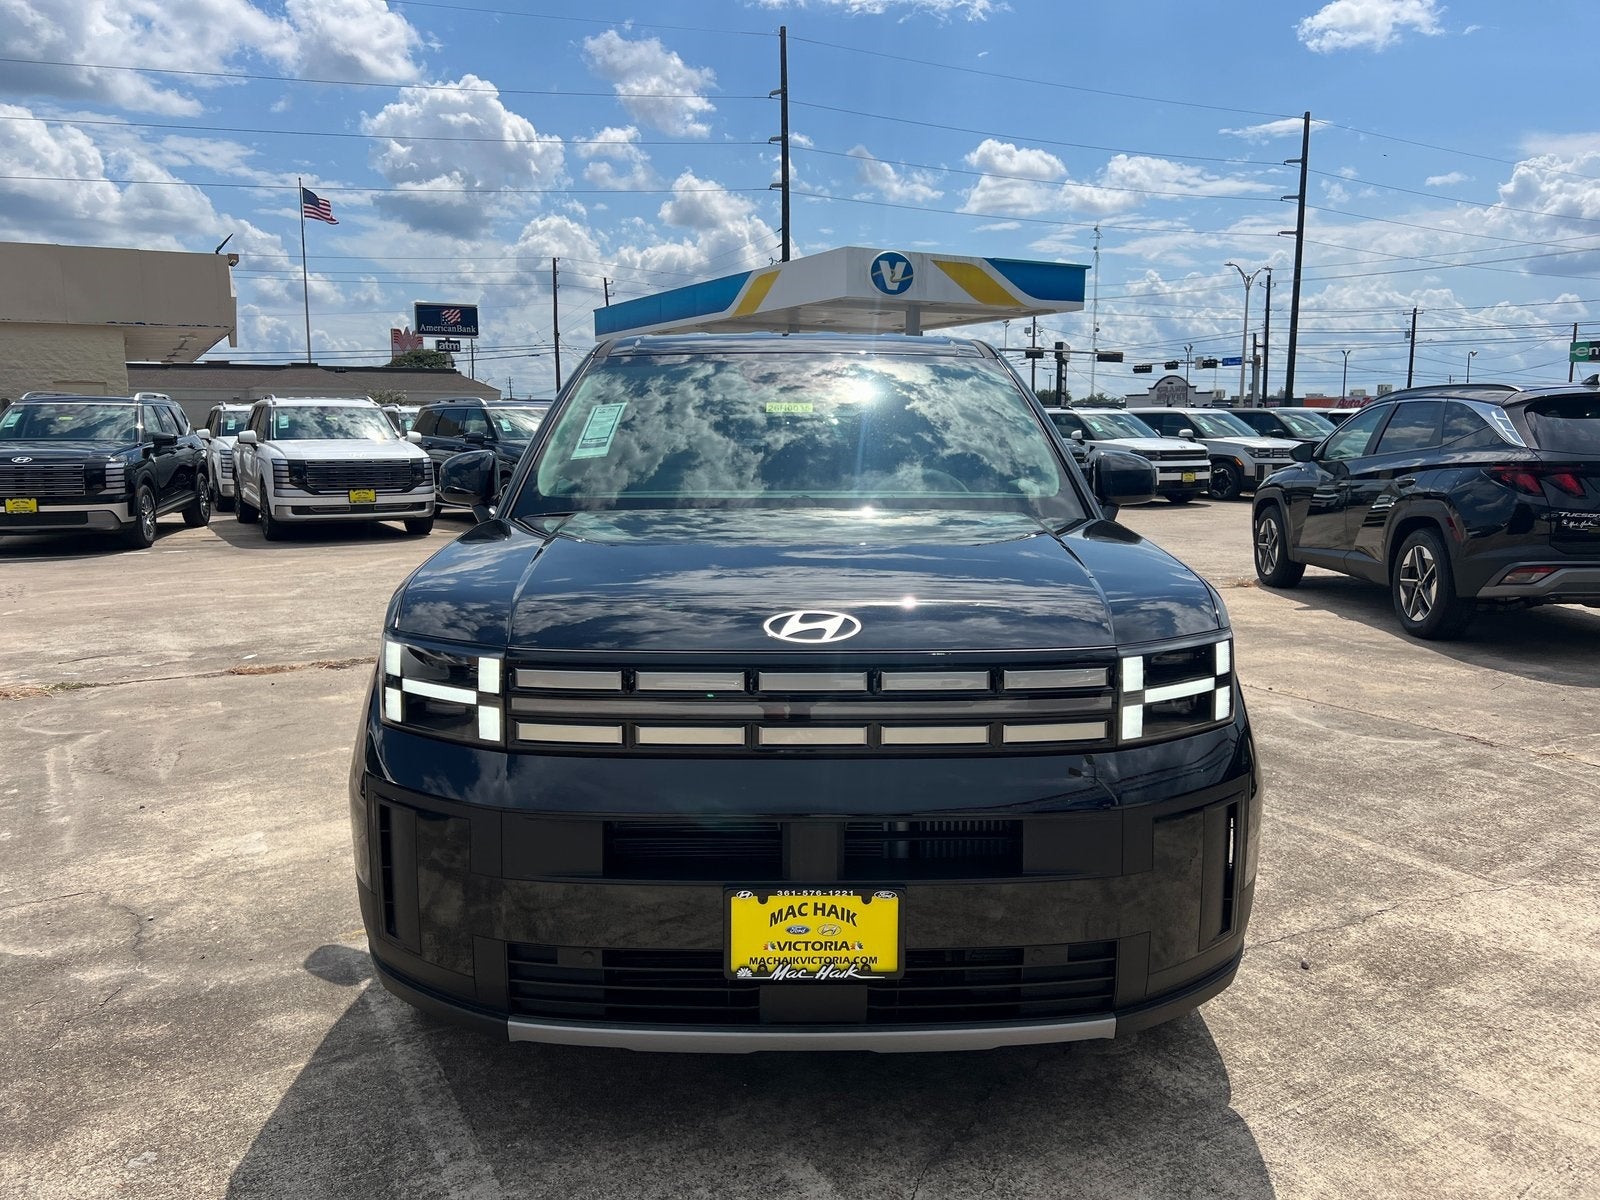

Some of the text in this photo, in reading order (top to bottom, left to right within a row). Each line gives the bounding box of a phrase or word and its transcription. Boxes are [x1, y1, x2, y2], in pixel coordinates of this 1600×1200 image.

[420, 324, 476, 333] AmericanBank
[439, 341, 460, 351] atm
[1575, 346, 1600, 356] en
[769, 902, 857, 927] MAC HAIK
[777, 941, 850, 951] VICTORIA
[749, 956, 878, 965] MACHAIKVICTORIA.COM
[770, 963, 862, 980] Mac Haik
